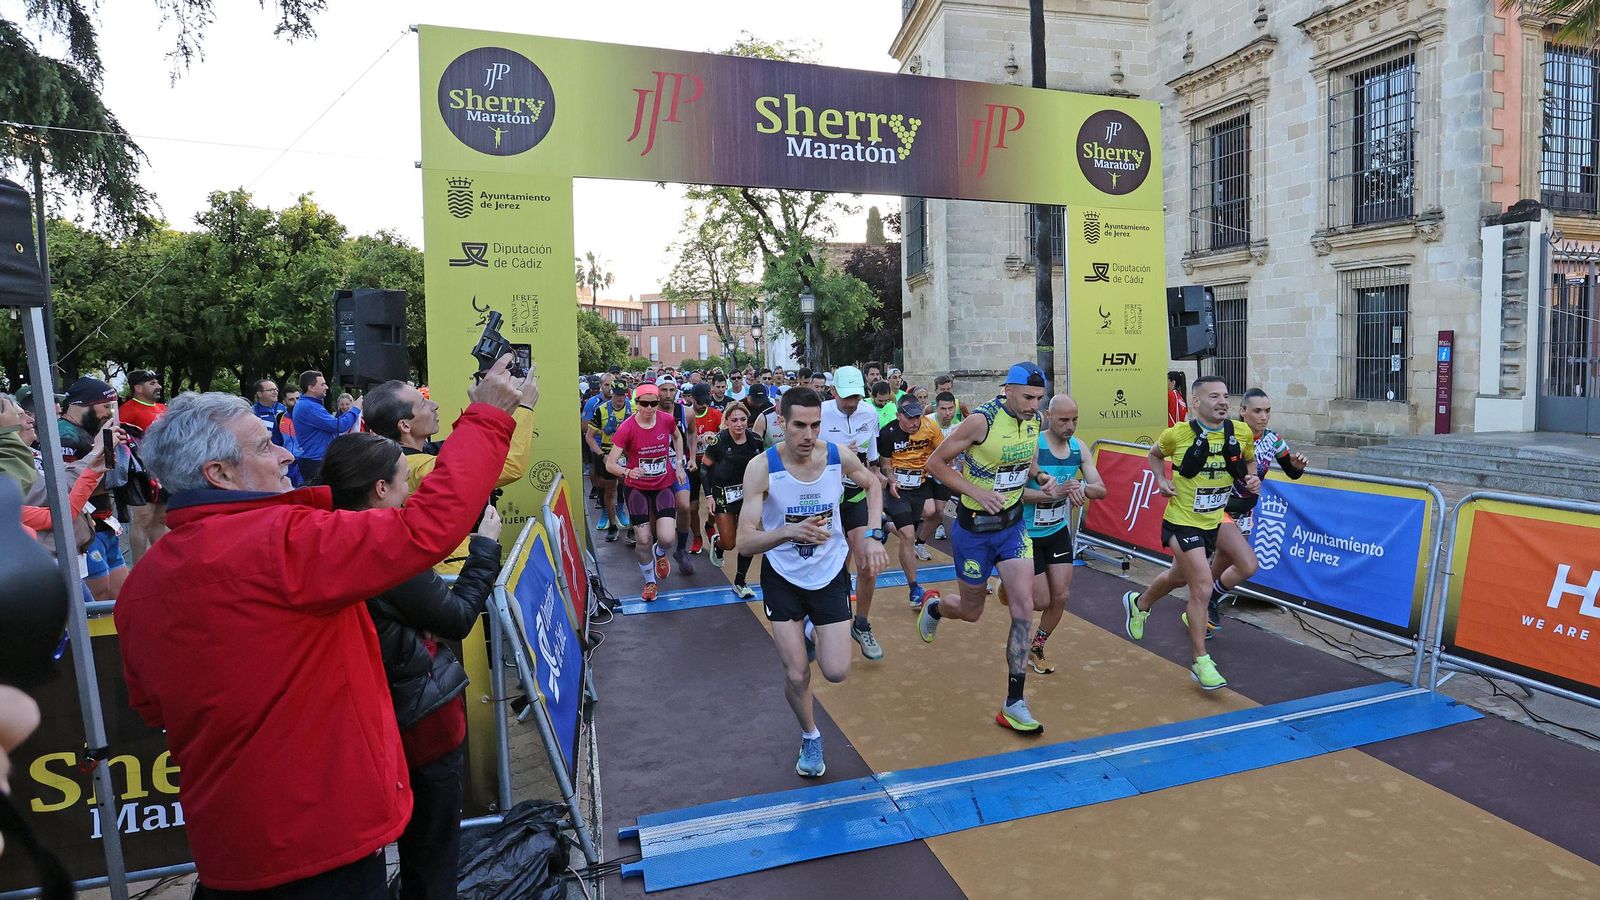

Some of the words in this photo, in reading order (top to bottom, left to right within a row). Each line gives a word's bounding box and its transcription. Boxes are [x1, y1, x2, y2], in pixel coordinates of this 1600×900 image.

[449, 88, 546, 123] Sherry
[466, 110, 531, 125] Maratón
[627, 71, 705, 157] JJP
[755, 93, 922, 161] Sherry
[786, 136, 897, 164] Maratón
[1083, 142, 1145, 169] Sherry
[1094, 159, 1136, 171] Maratón
[480, 191, 551, 202] Ayuntamiento
[480, 200, 493, 209] de
[495, 201, 521, 211] Jerez
[1104, 222, 1150, 231] Ayuntamiento
[1114, 230, 1131, 238] Jerez
[493, 242, 552, 255] Diputación
[494, 257, 508, 268] de
[511, 257, 542, 269] Cádiz
[1112, 263, 1151, 273] Diputación
[1112, 275, 1122, 284] de
[1124, 274, 1144, 284] Cádiz
[512, 294, 539, 302] JEREZ
[512, 326, 539, 334] SHERRY
[1102, 353, 1137, 366] HSN
[1099, 410, 1142, 419] SCALPERS
[531, 462, 560, 479] VALDESPIN
[905, 474, 911, 483] 3
[1008, 472, 1021, 482] 67
[1206, 494, 1222, 504] 130
[786, 502, 834, 514] RUNNERS
[1291, 524, 1385, 558] Ayuntamiento
[1288, 542, 1306, 559] de
[1306, 547, 1342, 567] Jerez
[1521, 614, 1545, 630] WE
[1553, 623, 1591, 641] ARE
